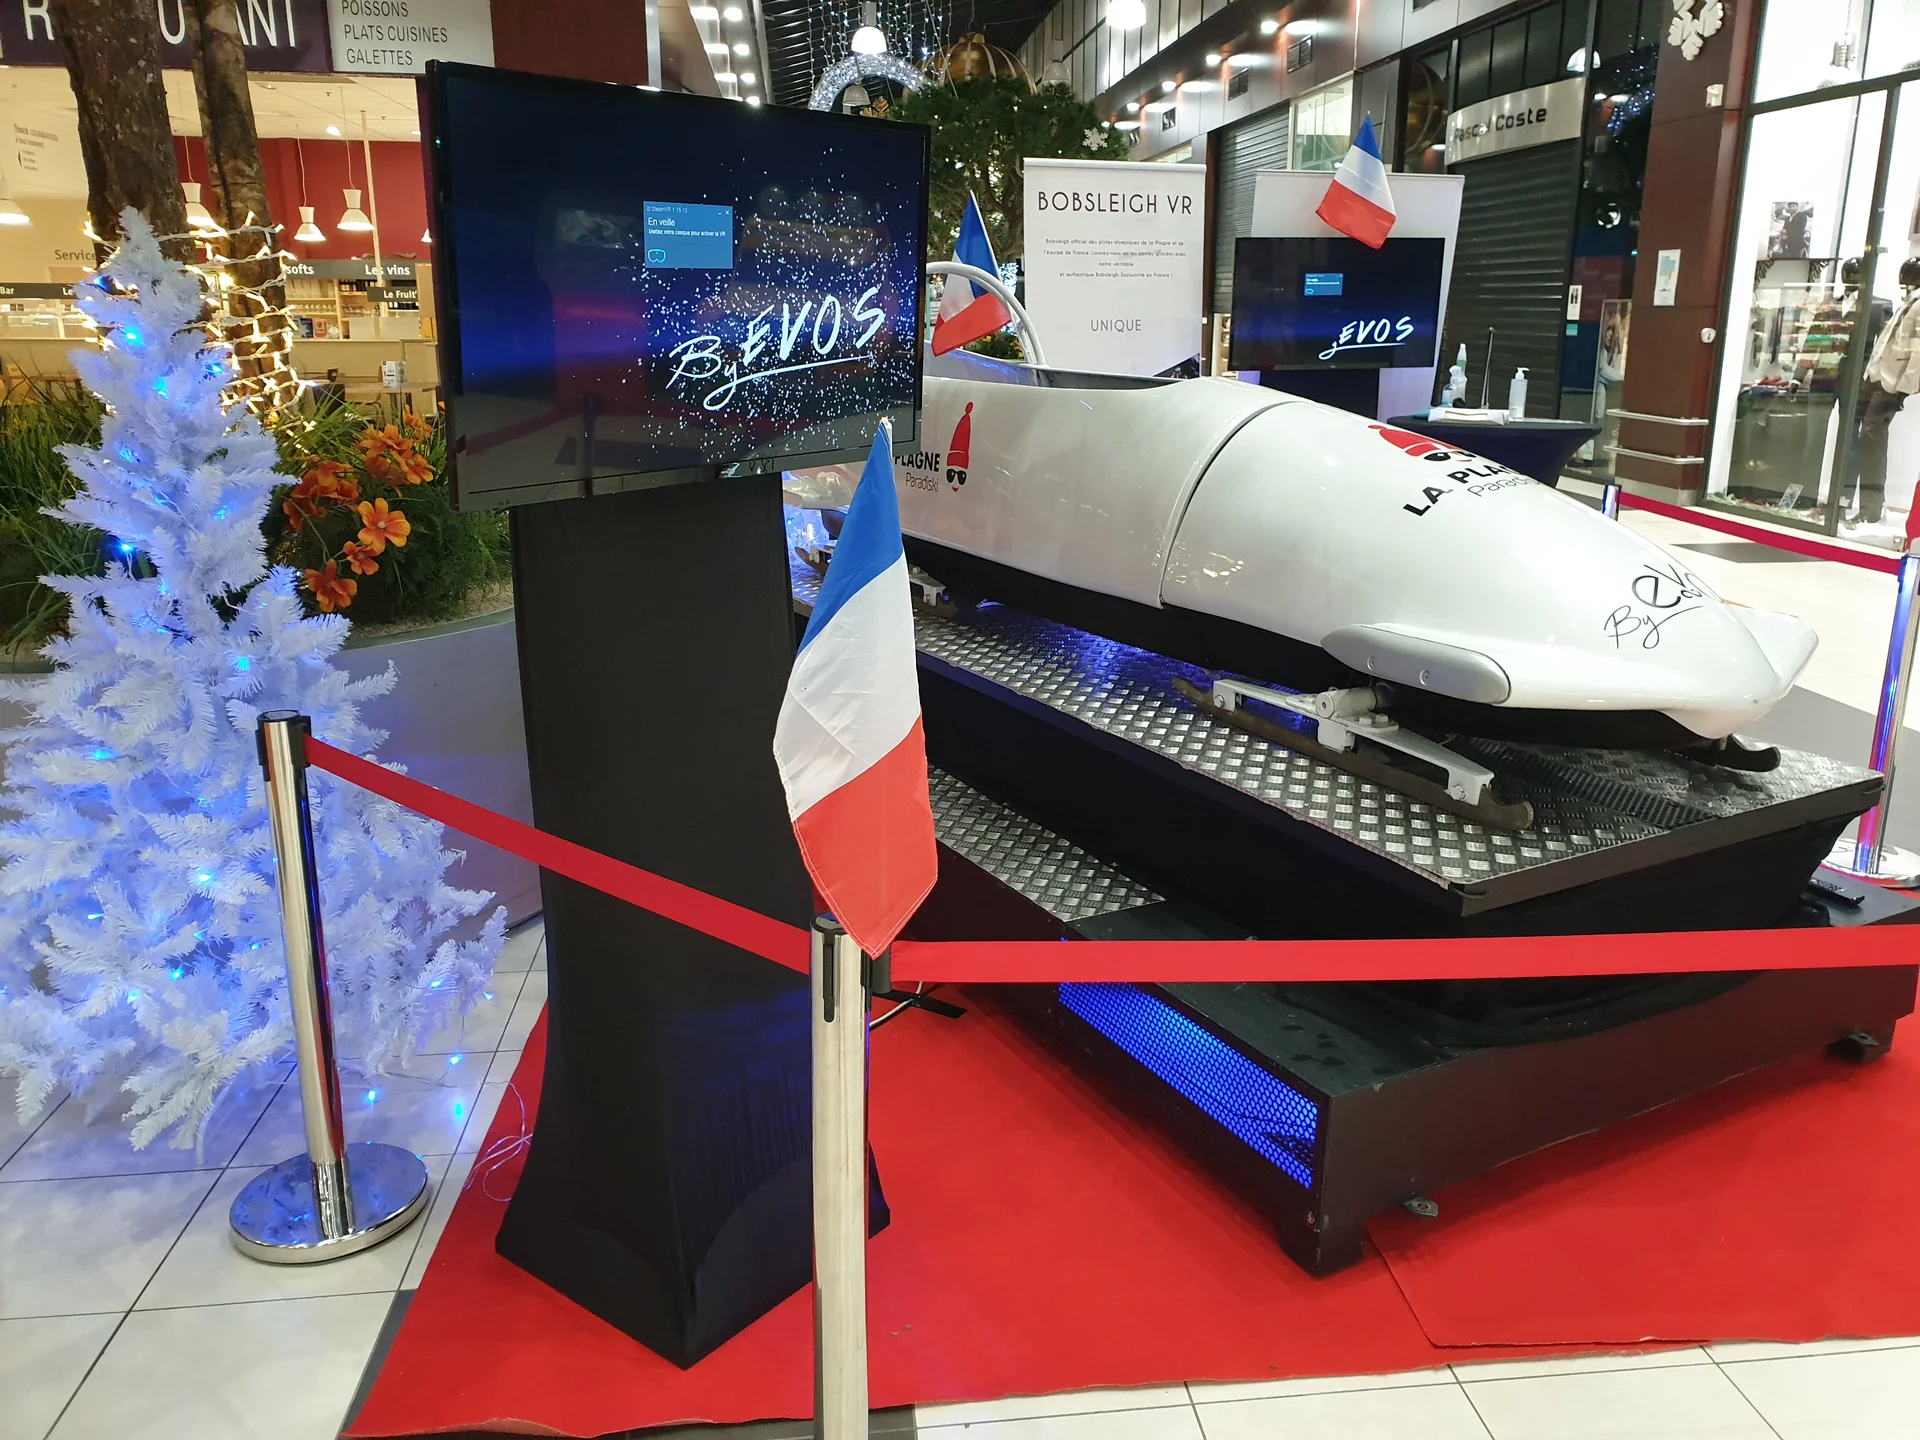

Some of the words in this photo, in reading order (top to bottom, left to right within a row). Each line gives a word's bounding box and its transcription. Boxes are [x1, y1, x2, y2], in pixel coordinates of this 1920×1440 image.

[342, 0, 409, 17] POISSONS
[344, 24, 384, 41] PLATS
[387, 26, 448, 43] CUISINES
[346, 48, 413, 65] GALETTES
[1495, 108, 1547, 131] Coste
[1038, 191, 1157, 213] BOBSLEIGH
[1167, 195, 1192, 214] VR
[647, 217, 658, 226] En
[659, 218, 676, 226] veille
[286, 263, 314, 275] softs
[365, 264, 384, 275] Les
[386, 264, 410, 275] vins
[383, 290, 392, 298] Le
[742, 286, 886, 367] EVOS
[1090, 319, 1142, 333] UNIQUE
[1338, 315, 1414, 345] EVOS
[905, 472, 939, 492] Paradiski
[1402, 486, 1454, 517] LA
[1604, 605, 1688, 649] By
